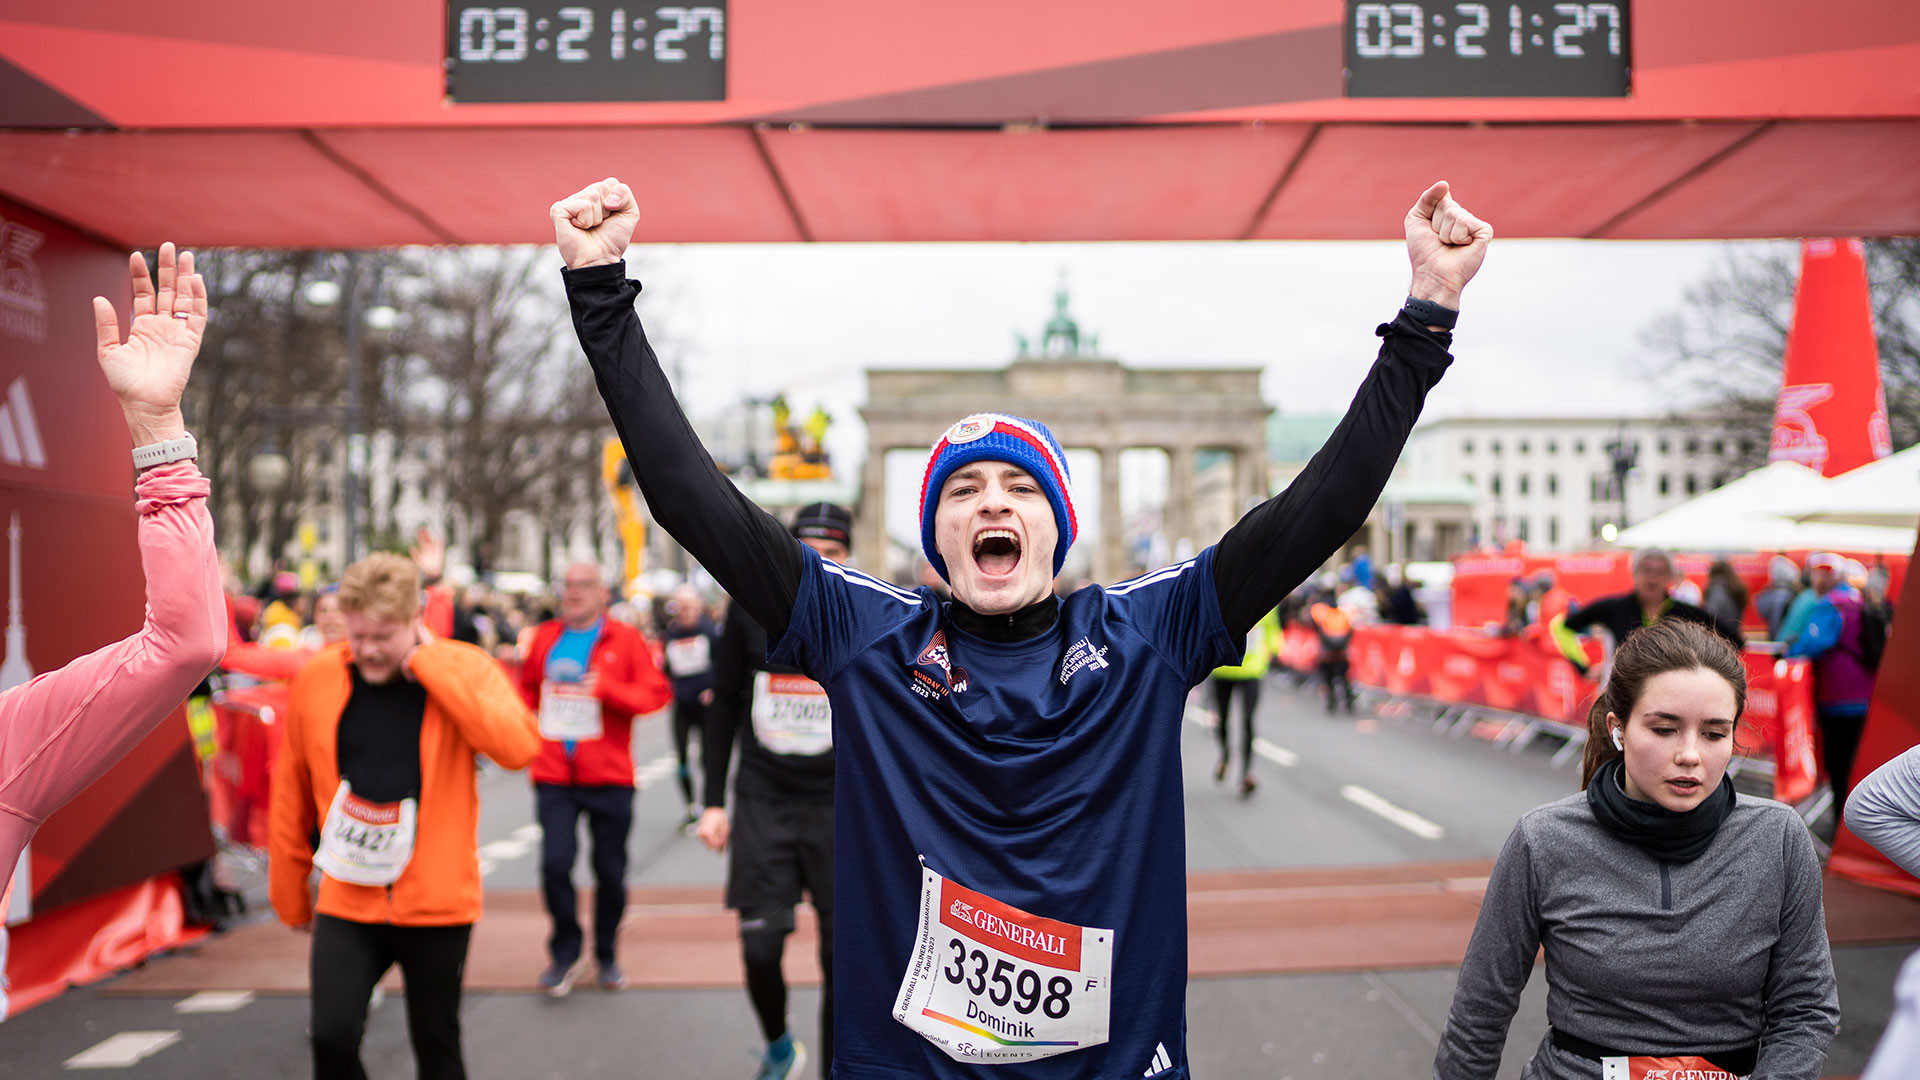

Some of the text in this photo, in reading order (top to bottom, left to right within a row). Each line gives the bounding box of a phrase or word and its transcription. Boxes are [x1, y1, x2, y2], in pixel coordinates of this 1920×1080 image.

[459, 7, 724, 62] 03:21:27
[1355, 3, 1620, 57] 03:21:27
[913, 669, 940, 690] SUNDAY
[1062, 645, 1108, 685] HALBMARAON
[910, 683, 930, 698] 2023
[901, 975, 918, 1012] GENERALI
[913, 944, 927, 978] BERLINER
[921, 889, 931, 945] HALBMARATHON
[927, 937, 936, 954] 2023
[973, 909, 1067, 956] GENERALI
[924, 954, 934, 972] April
[943, 938, 1073, 1019] 33598
[1085, 980, 1098, 992] F
[966, 999, 1035, 1038] Dominik
